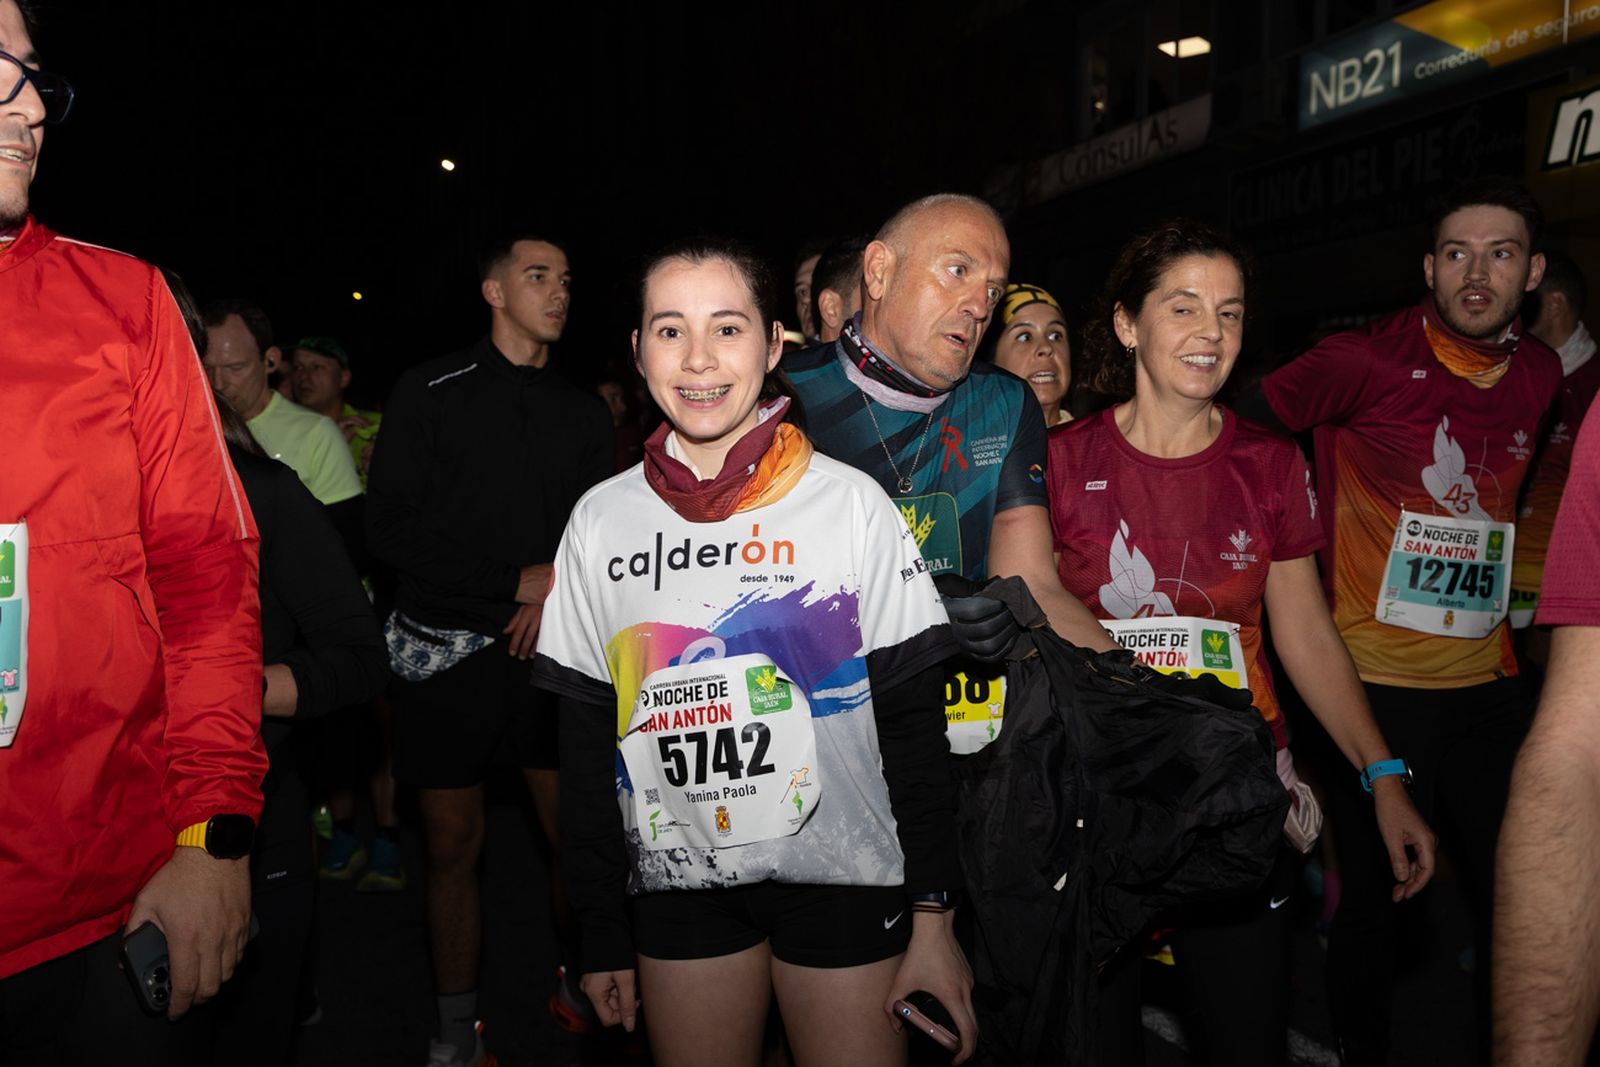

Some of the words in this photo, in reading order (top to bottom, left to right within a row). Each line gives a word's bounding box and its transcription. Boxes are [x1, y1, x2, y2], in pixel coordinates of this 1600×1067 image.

[1309, 40, 1402, 116] NB21
[1505, 28, 1530, 49] de
[1444, 483, 1475, 514] 43
[1423, 528, 1464, 544] NOCHE
[1465, 533, 1479, 545] DE
[607, 524, 794, 591] calderón
[1404, 540, 1433, 555] SAN
[1434, 544, 1477, 561] ANTÓN
[740, 574, 768, 583] desde
[774, 574, 795, 583] 1949
[1406, 557, 1494, 599] 12745
[1436, 597, 1466, 608] Alberto
[1117, 634, 1167, 648] NOCHE
[1170, 634, 1189, 647] DE
[1136, 648, 1188, 668] ANTÓN
[689, 674, 726, 685] INTERNACIONAL
[653, 685, 704, 708] NOCHE
[707, 680, 728, 700] DE
[673, 700, 733, 730] ANTÓN
[658, 722, 775, 787] 5742
[684, 787, 720, 803] Yanina
[723, 784, 757, 800] Paola
